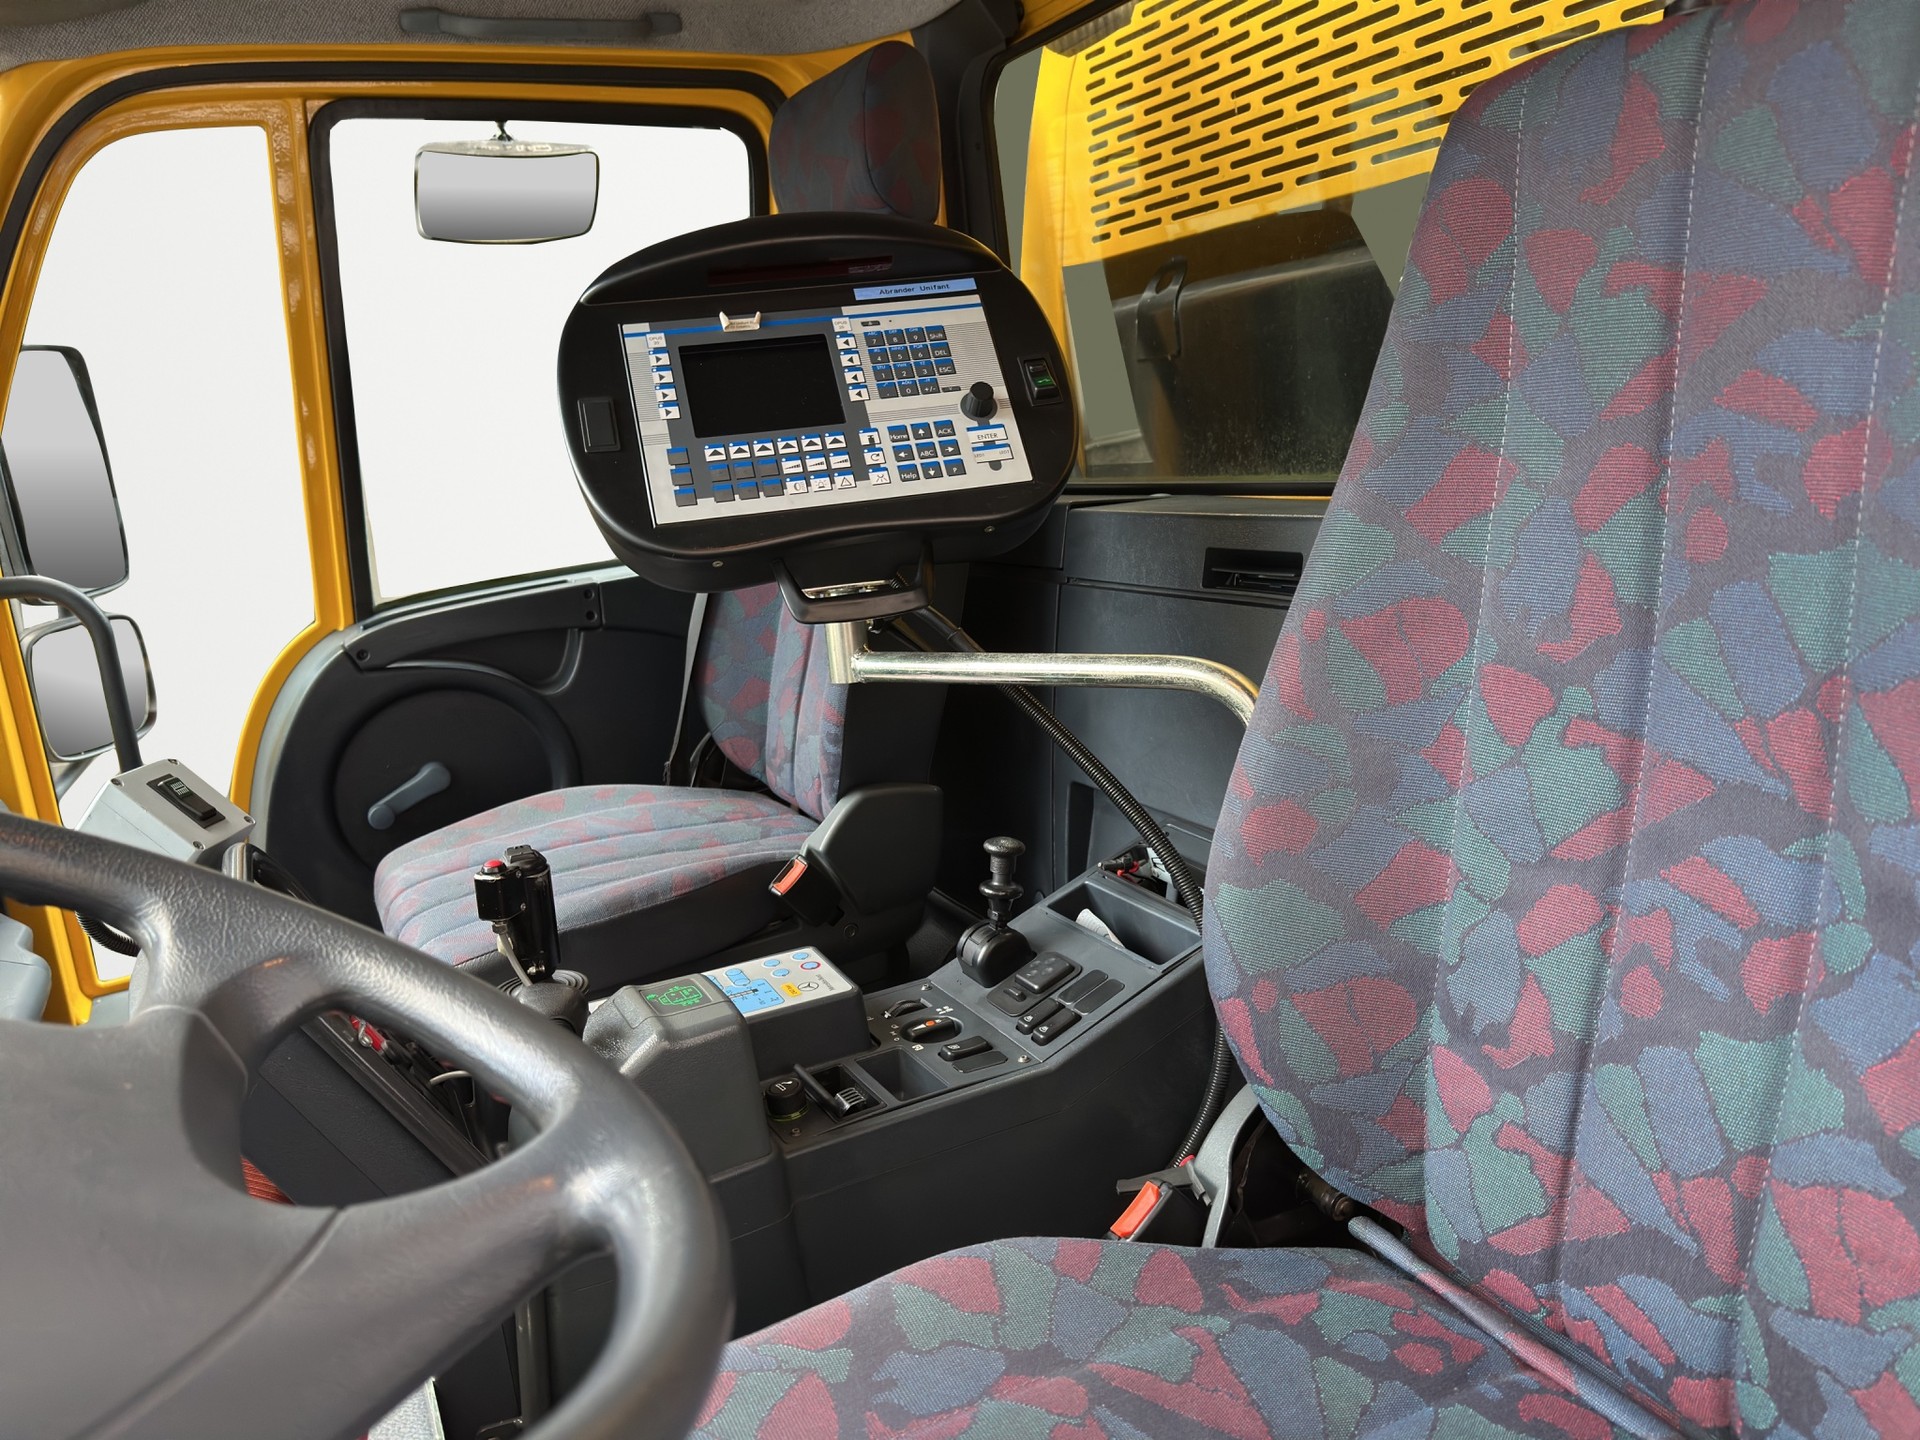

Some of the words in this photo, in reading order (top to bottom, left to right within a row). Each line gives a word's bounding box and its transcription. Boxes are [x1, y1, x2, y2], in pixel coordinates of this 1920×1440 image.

[879, 286, 915, 295] Abrander
[919, 283, 950, 293] Unifant
[977, 433, 998, 441] ENTER
[901, 472, 917, 480] Help
